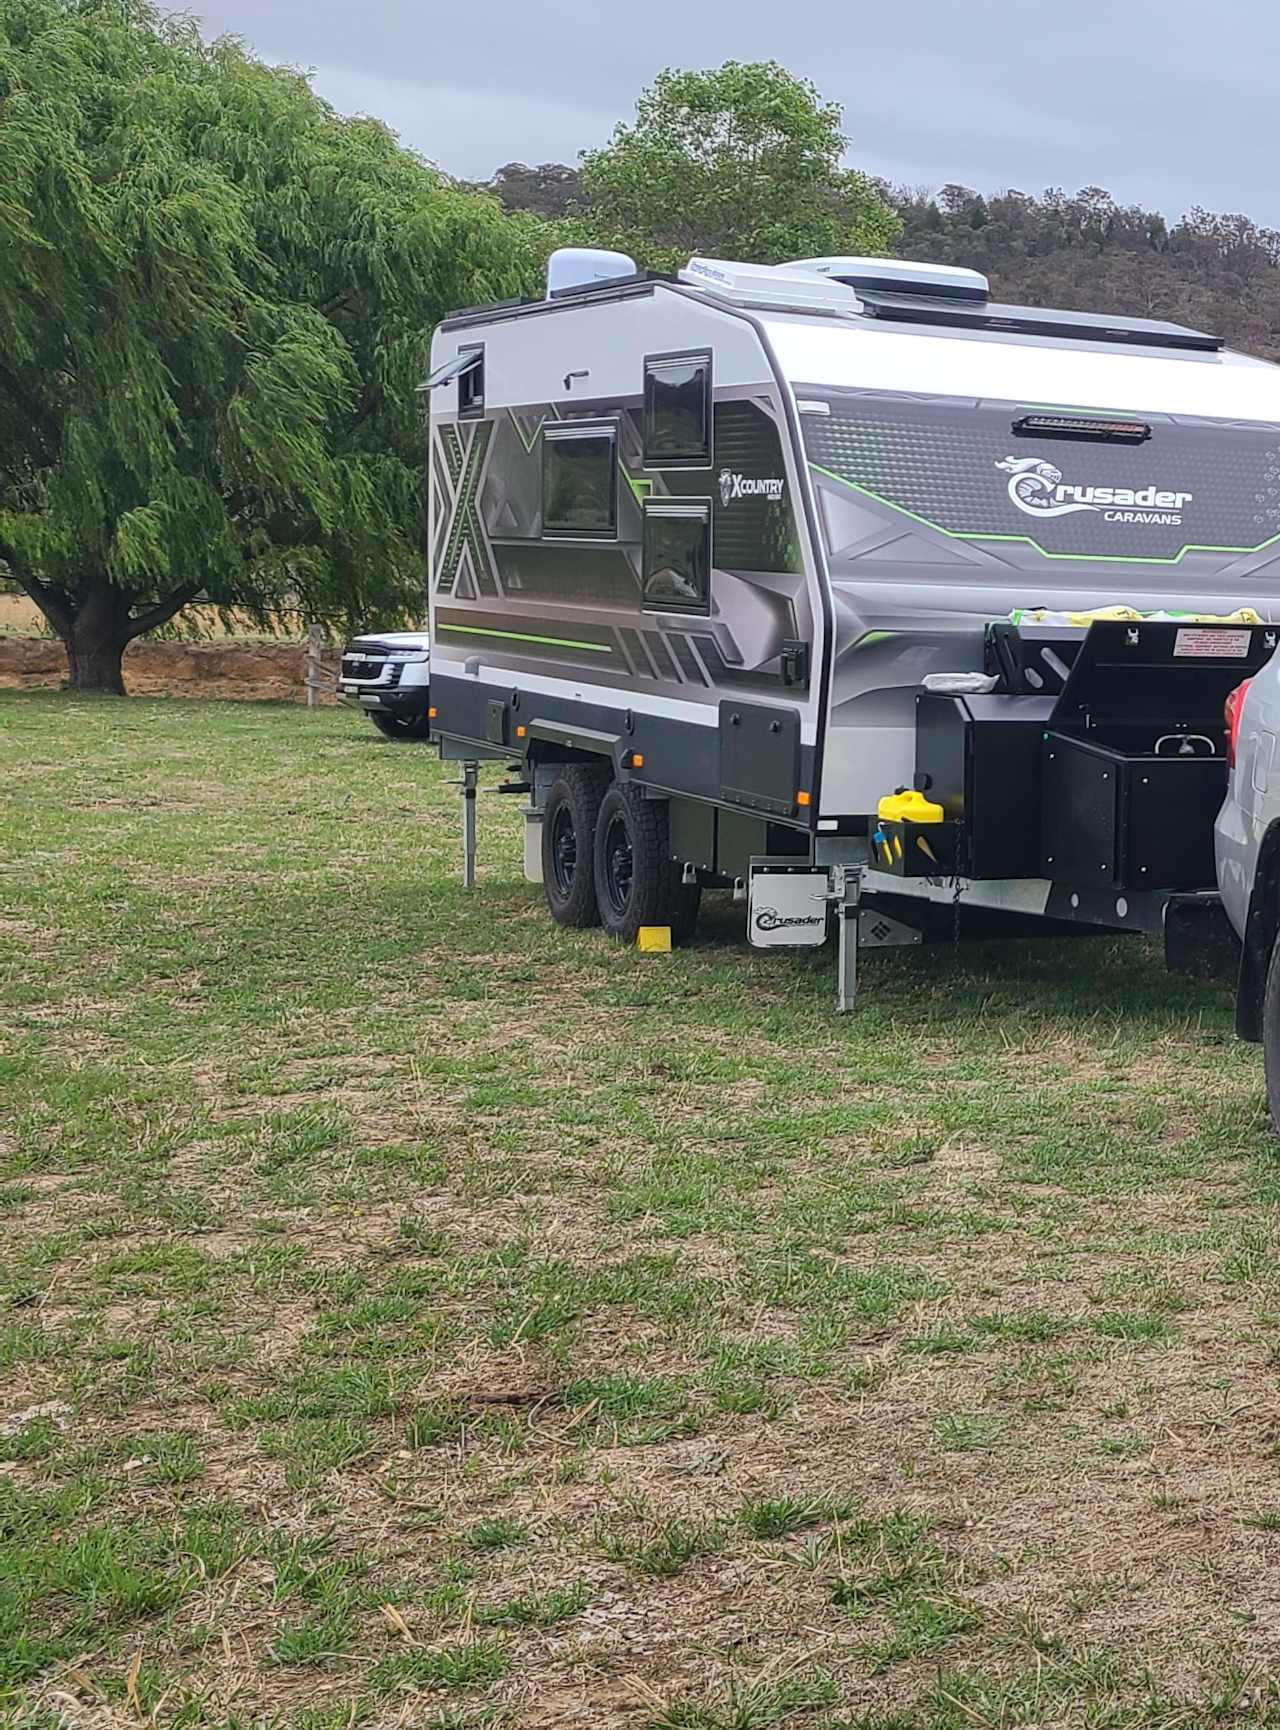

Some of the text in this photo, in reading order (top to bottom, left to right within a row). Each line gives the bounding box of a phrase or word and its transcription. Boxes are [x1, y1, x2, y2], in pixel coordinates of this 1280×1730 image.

[1008, 471, 1193, 518] Crusader
[1104, 510, 1182, 526] CARAVANS
[755, 912, 824, 931] Crusader
